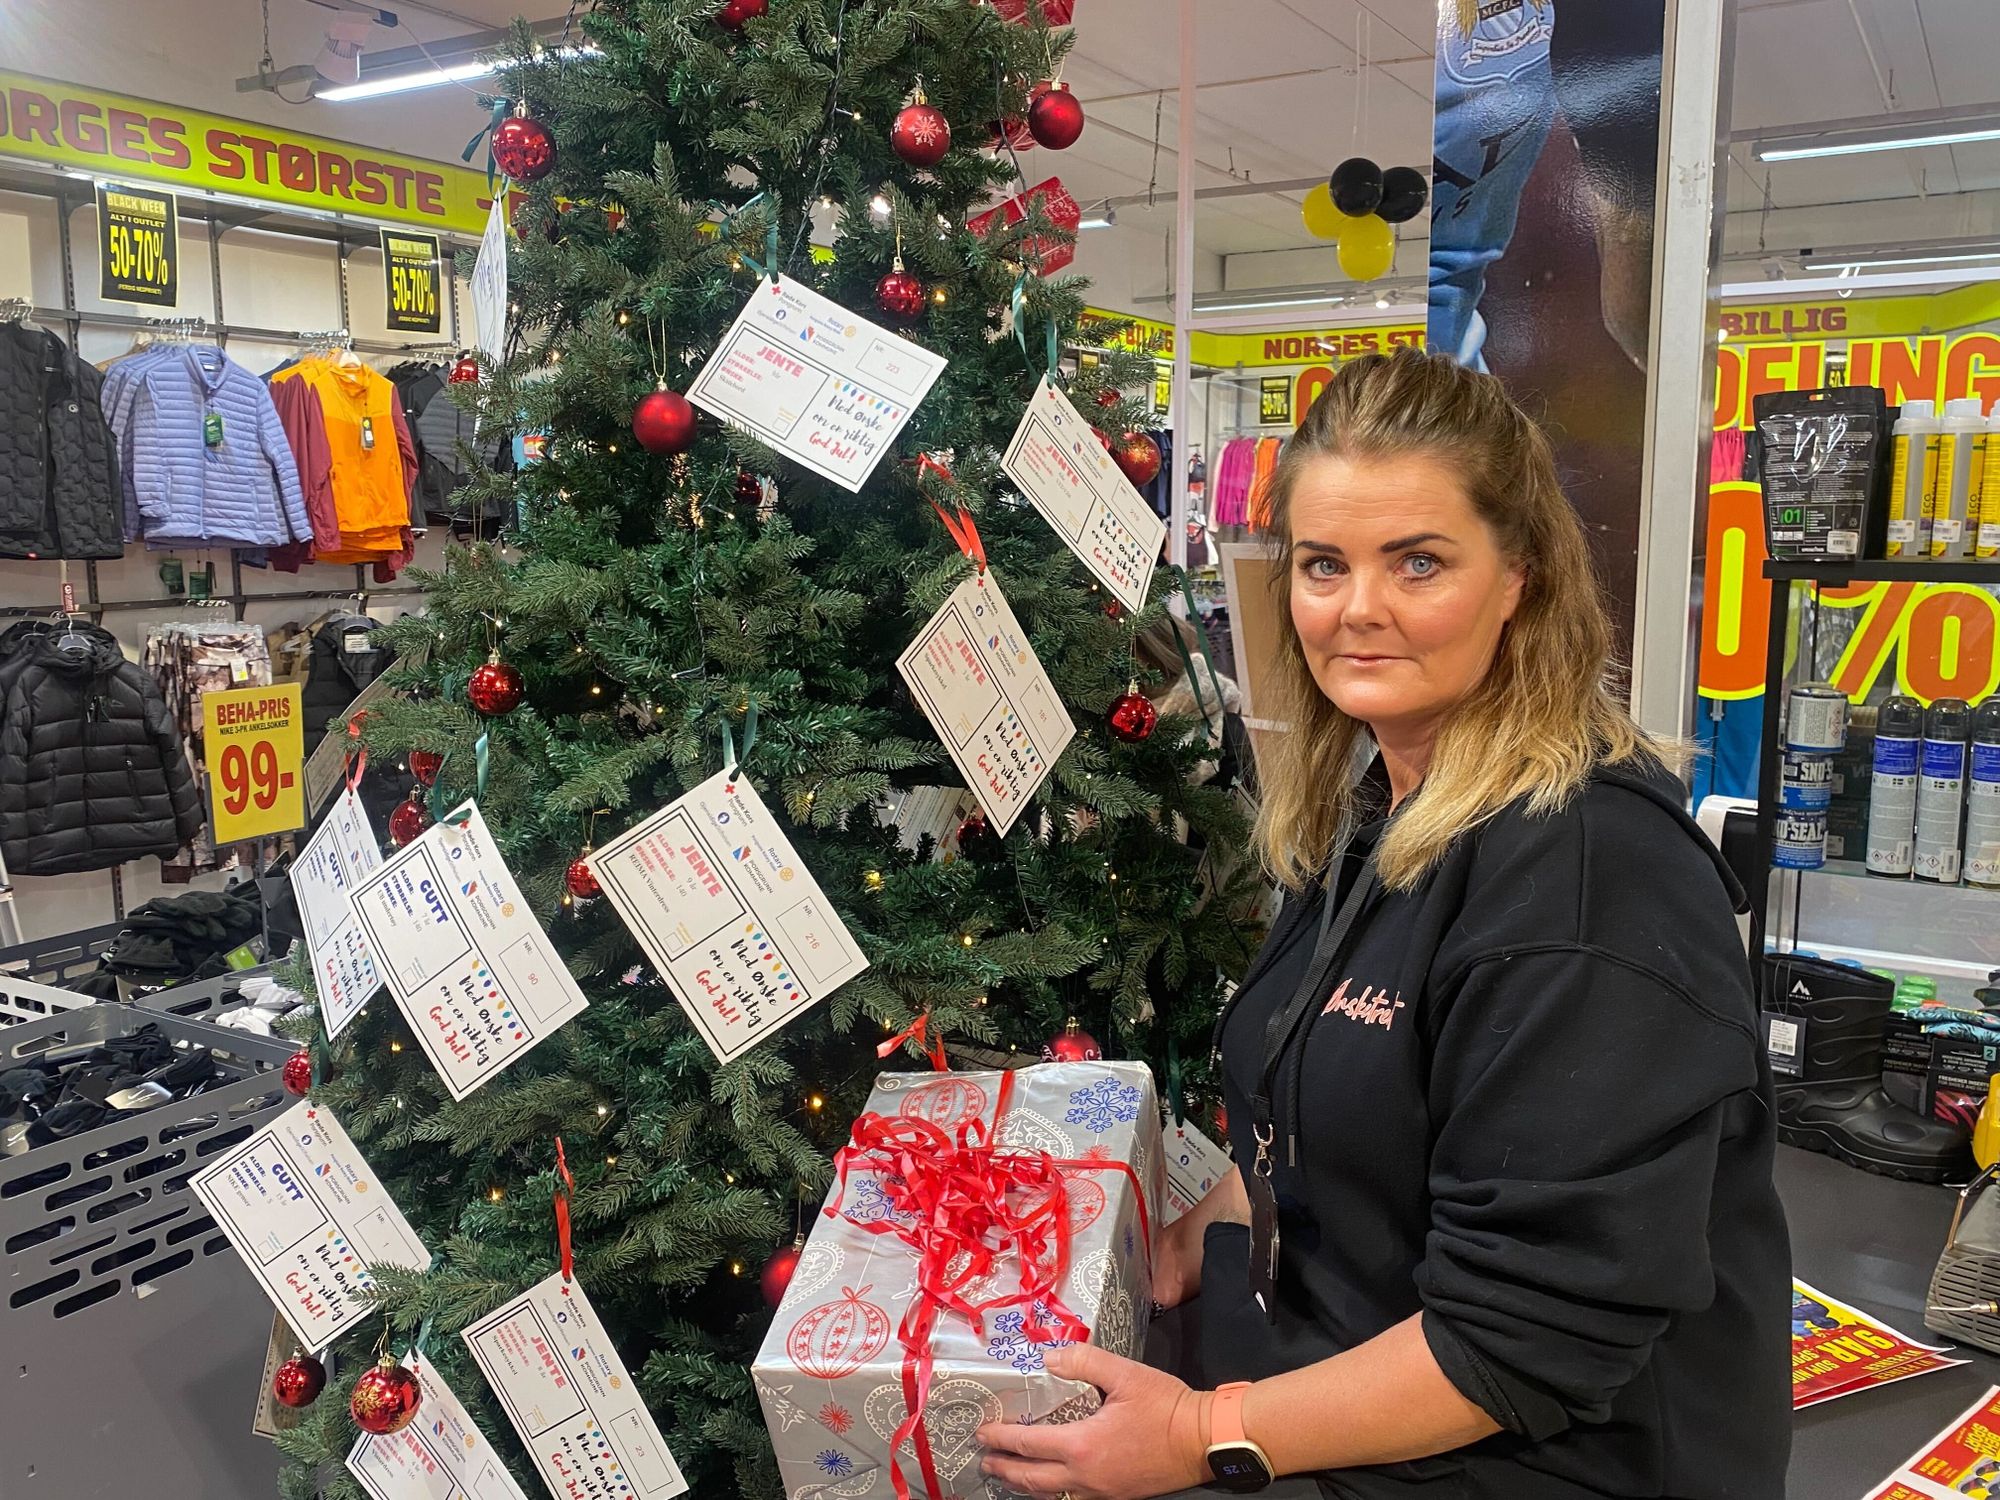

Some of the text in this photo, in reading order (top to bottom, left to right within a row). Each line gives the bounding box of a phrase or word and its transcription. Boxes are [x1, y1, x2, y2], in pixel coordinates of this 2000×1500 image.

[0, 88, 445, 215] RGES STØRSTE
[110, 213, 126, 222] ALT
[133, 218, 166, 228] OUTLET
[109, 225, 168, 285] 50-70%
[391, 266, 435, 315] 50-70%
[1721, 307, 1847, 336] BILLIG
[755, 344, 805, 378] JENTE
[1264, 332, 1378, 359] NORGES
[807, 429, 857, 464] God Jul!
[838, 424, 881, 457] riktig
[1045, 441, 1080, 487] JENTE
[955, 635, 986, 686] JENTE
[217, 697, 290, 725] BEHA-PRIS
[220, 720, 289, 736] NIKE 3-PK ANKELSOKKER
[995, 720, 1031, 780] Med Ønske
[976, 752, 1007, 803] God Jul!
[997, 760, 1024, 804] riktig
[725, 798, 749, 827] Porsgrunn
[732, 794, 755, 824] Røde Kors
[655, 832, 676, 859] ALDER:
[766, 847, 784, 869] Rotary
[328, 849, 343, 891] GUTT
[398, 869, 416, 895] ALDER:
[627, 853, 671, 913] REIMA Vinterdress
[645, 838, 687, 897] STØRRELSE: 140
[679, 841, 723, 897] JENTE
[742, 863, 764, 892] KOMMUNE
[747, 859, 773, 894] PORSGRUNN
[381, 881, 399, 908] ØNSKE:
[388, 875, 415, 917] STØRRELSE:
[416, 877, 450, 926] GUTT
[490, 881, 506, 905] Rotary
[804, 932, 820, 950] 216
[527, 971, 538, 986] 90
[707, 947, 727, 971] om
[726, 981, 770, 1031] riktig
[730, 937, 784, 1008] Med Ønske
[458, 974, 509, 1048] Med Ønske
[694, 967, 741, 1026] God Jul!
[427, 1003, 470, 1065] God Jul!
[438, 983, 456, 1007] om
[457, 1018, 495, 1069] riktig
[1985, 1049, 1994, 1058] 2
[225, 1173, 240, 1191] NIKE
[231, 1166, 250, 1190] ØNSKE:
[239, 1160, 267, 1196] STØRRELSE:
[248, 1154, 267, 1178] ALDER:
[270, 1161, 304, 1203] GUTT
[314, 1243, 340, 1272] Med
[284, 1270, 326, 1321] God Jul!
[295, 1252, 313, 1272] om
[313, 1281, 351, 1324] riktig
[491, 1334, 517, 1375] Sparkesykkel
[530, 1333, 566, 1388] JENTE
[1816, 1329, 1896, 1362] 9 ÅR
[597, 1353, 613, 1376] Rotary
[1806, 1359, 1840, 1375] SOM
[401, 1429, 438, 1475] JENTE
[575, 1432, 599, 1463] Med
[634, 1445, 645, 1457] 23
[1963, 1422, 1989, 1453] SPORT
[550, 1451, 571, 1478] God
